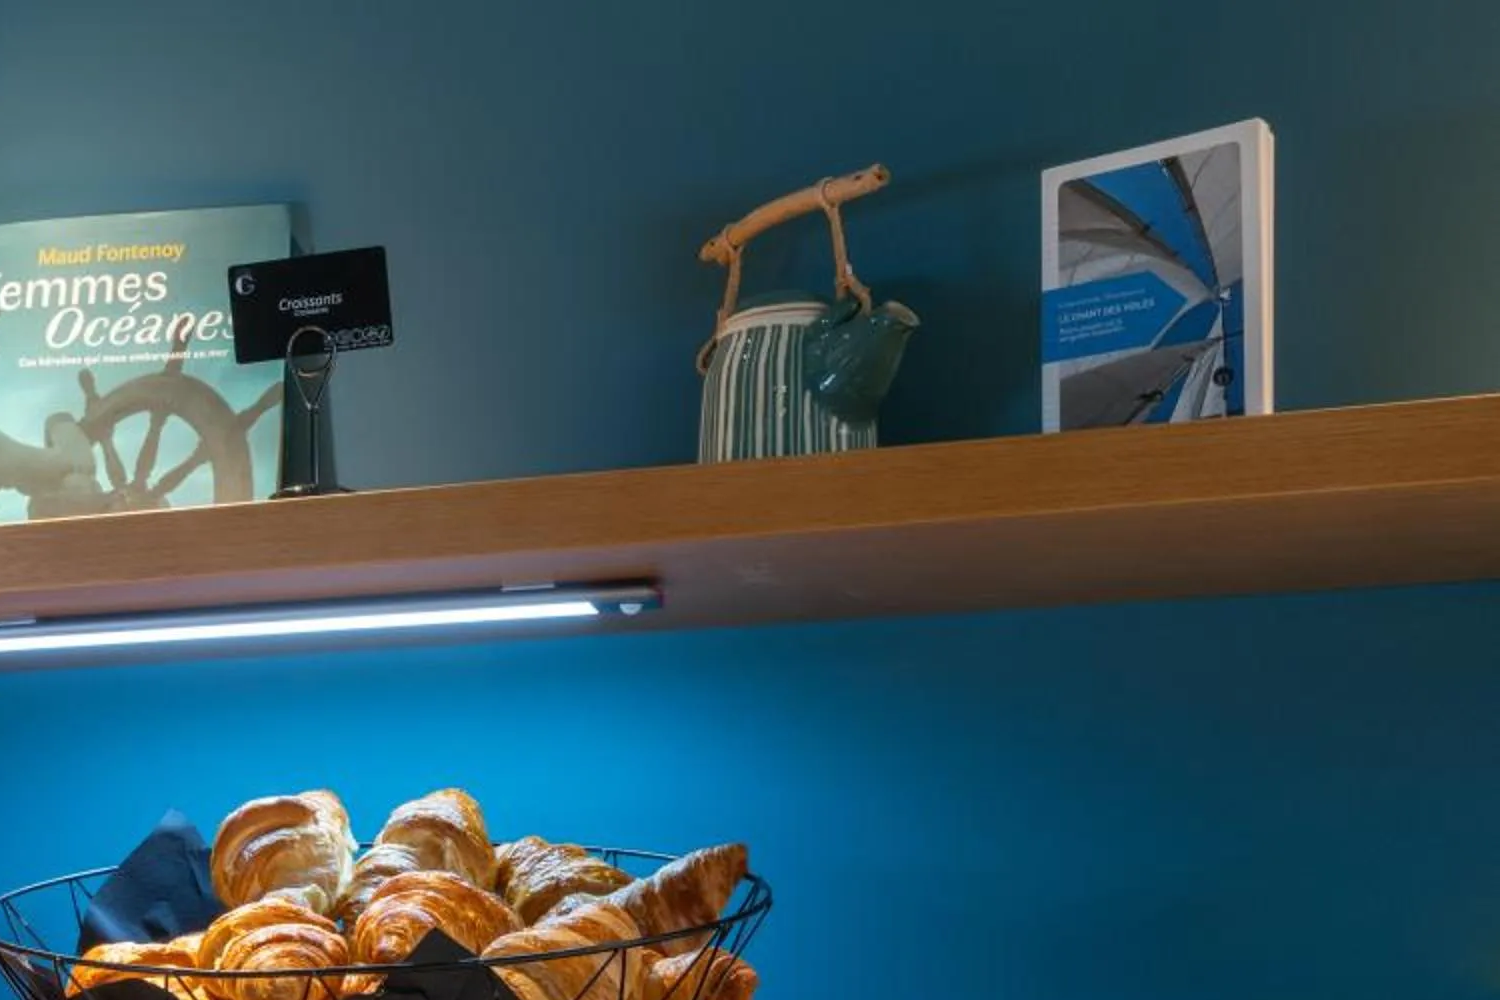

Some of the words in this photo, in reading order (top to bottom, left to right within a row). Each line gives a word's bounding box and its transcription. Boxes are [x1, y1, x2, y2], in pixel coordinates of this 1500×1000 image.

[39, 246, 91, 267] Maud
[97, 241, 186, 265] Fontenoy
[278, 292, 344, 311] Croissants
